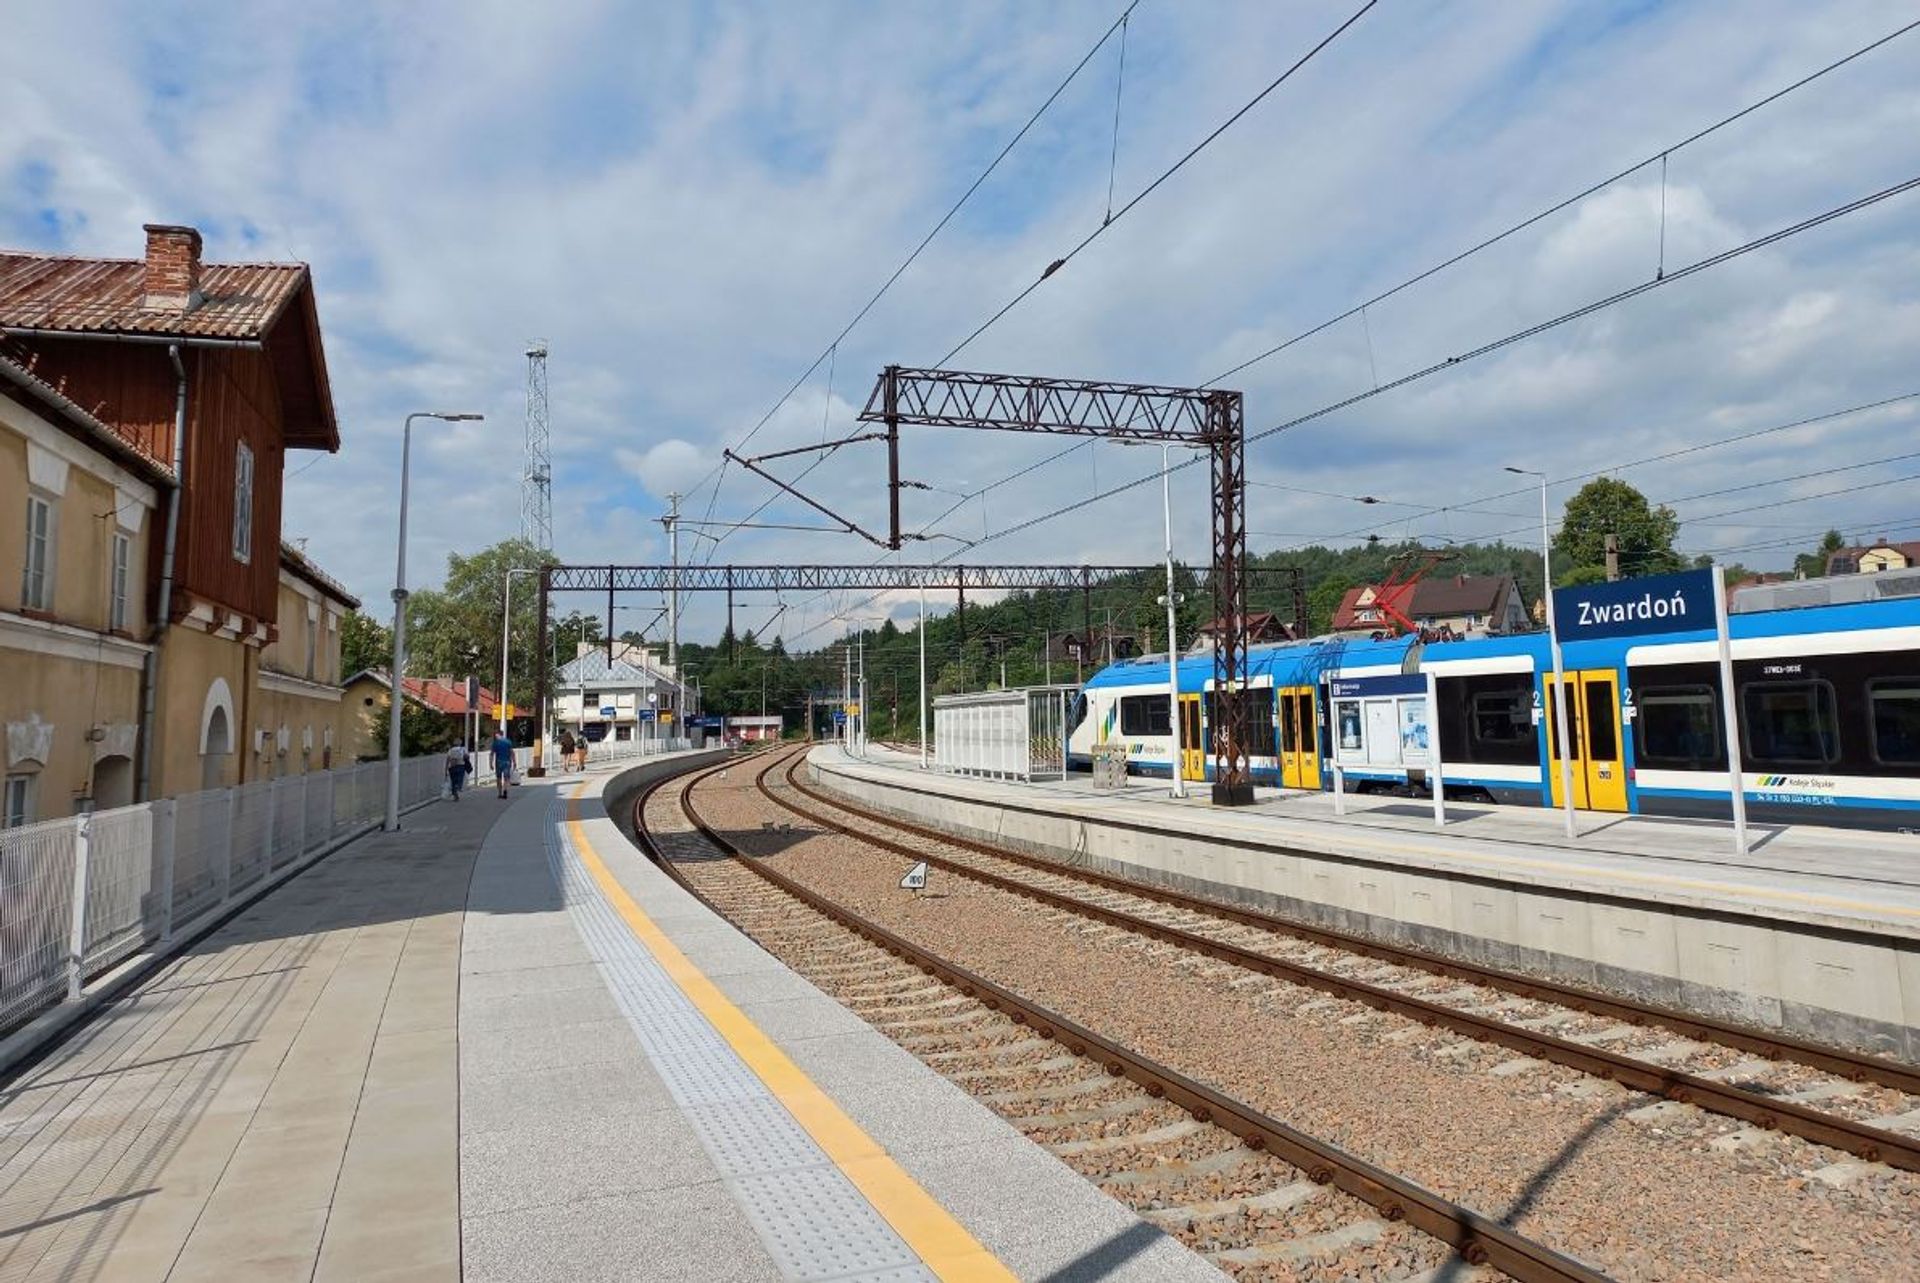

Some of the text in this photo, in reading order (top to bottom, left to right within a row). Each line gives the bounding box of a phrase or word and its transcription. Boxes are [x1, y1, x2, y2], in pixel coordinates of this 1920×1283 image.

[1578, 590, 1686, 626] Zwardoń
[1532, 691, 1541, 706] 2
[1624, 688, 1633, 704] 2
